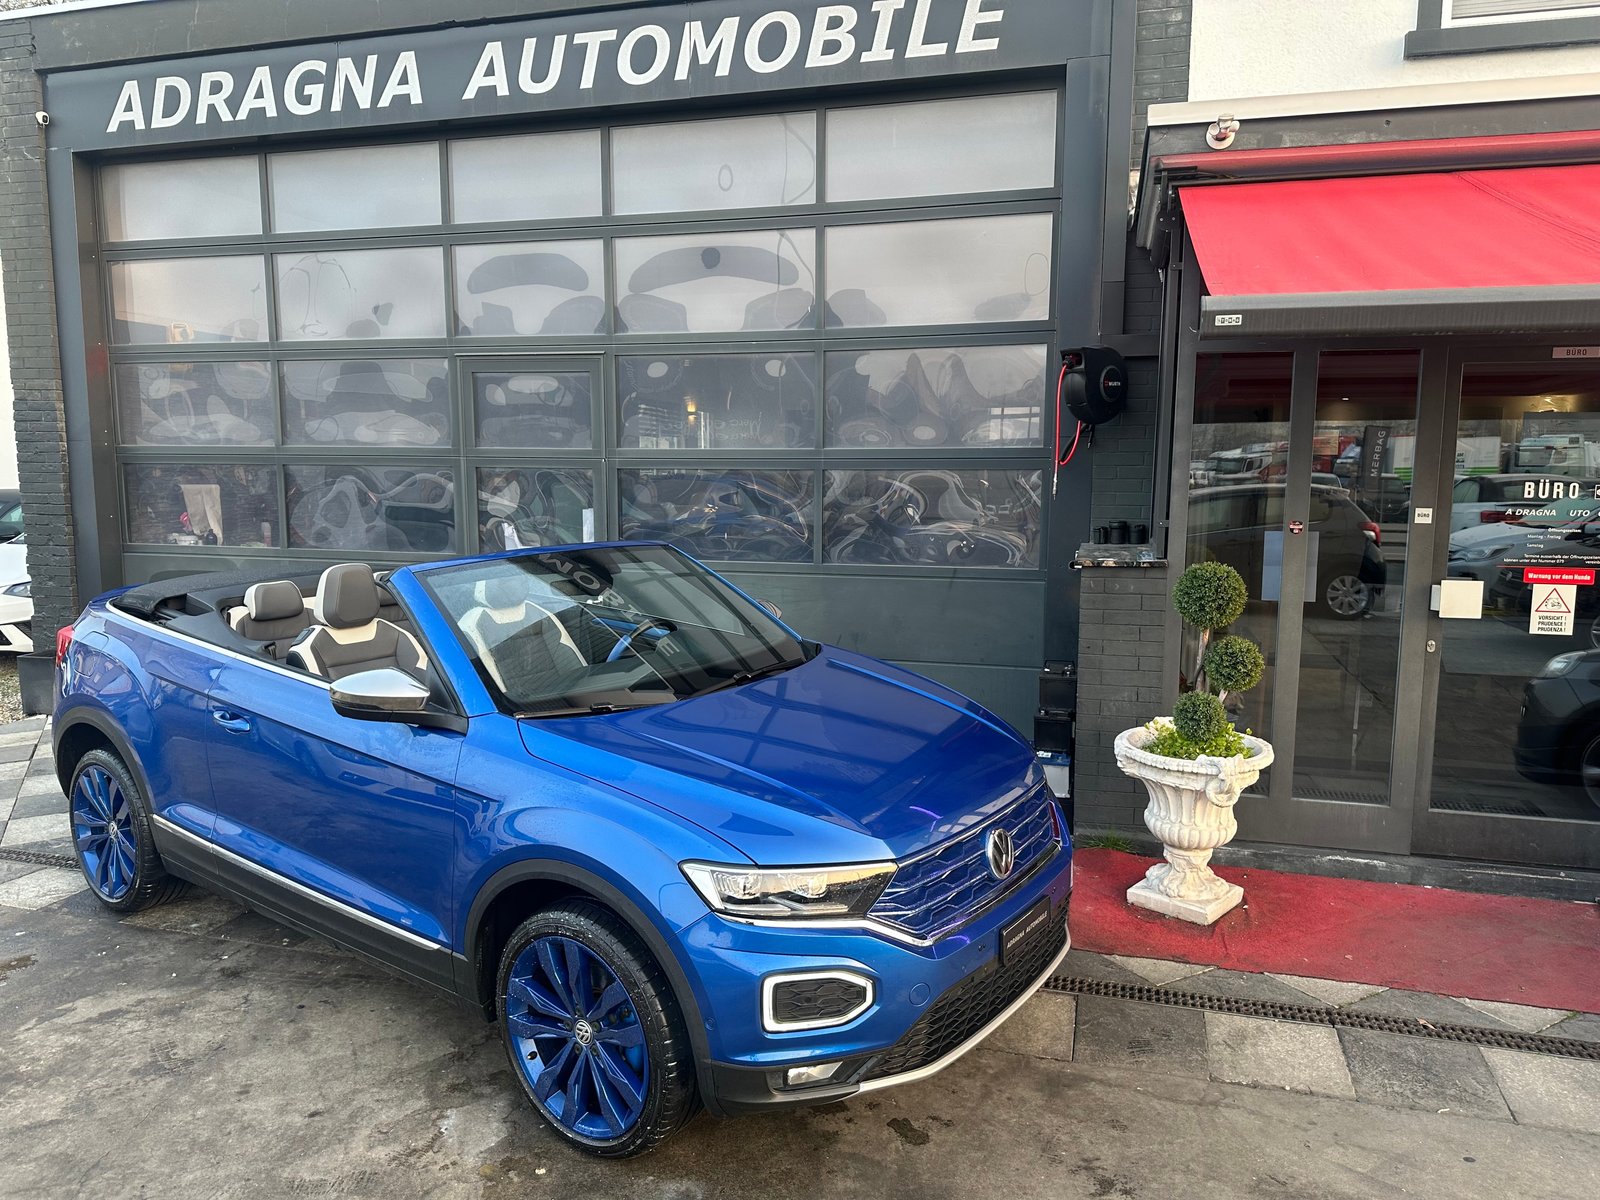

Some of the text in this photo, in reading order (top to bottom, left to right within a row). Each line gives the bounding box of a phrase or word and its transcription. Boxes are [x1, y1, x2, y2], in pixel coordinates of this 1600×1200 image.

[106, 0, 1004, 133] ADRAGNA AUTOMOBILE
[1566, 348, 1587, 356] BÜRO
[1370, 430, 1386, 477] MERBAG
[1524, 479, 1579, 499] BÜRO
